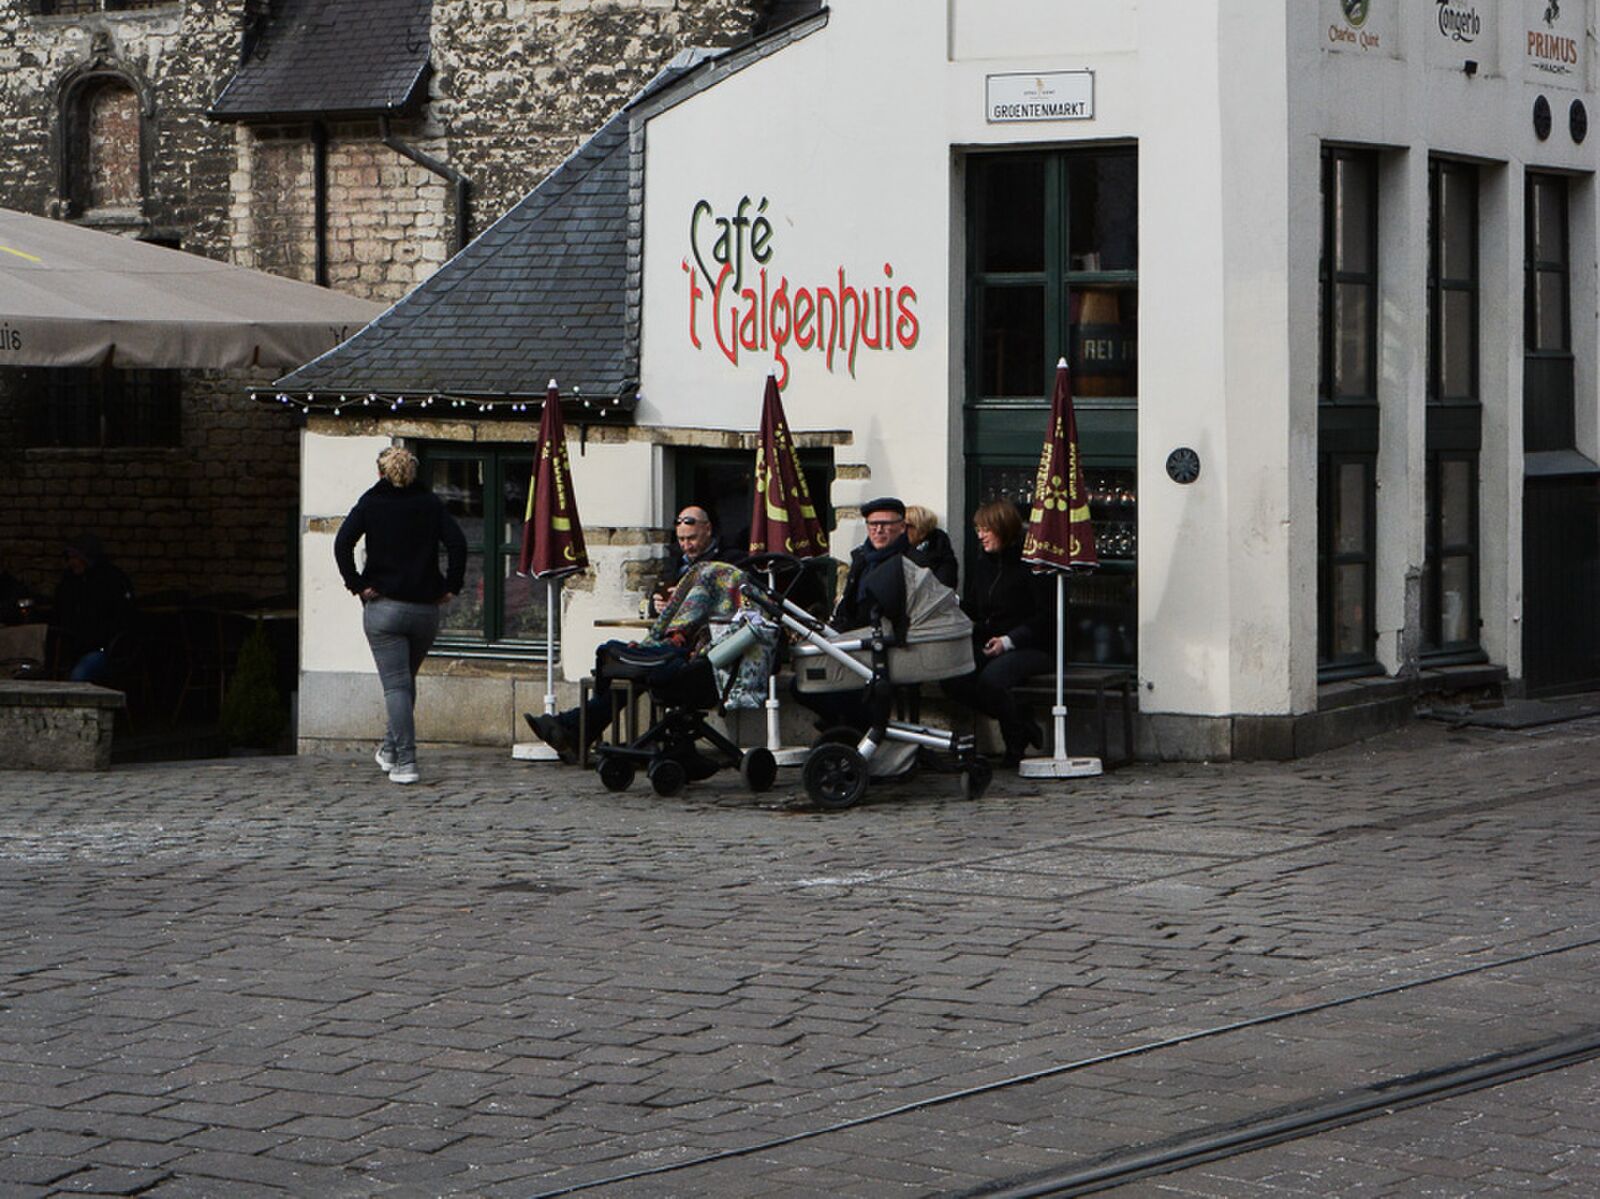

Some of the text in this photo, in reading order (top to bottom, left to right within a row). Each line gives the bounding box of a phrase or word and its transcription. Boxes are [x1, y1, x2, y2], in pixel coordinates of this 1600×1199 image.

[1527, 30, 1578, 66] PRIMUS
[993, 102, 1086, 118] GROENTENMARKT
[690, 195, 774, 294] Café
[712, 260, 921, 392] Galgenhuis
